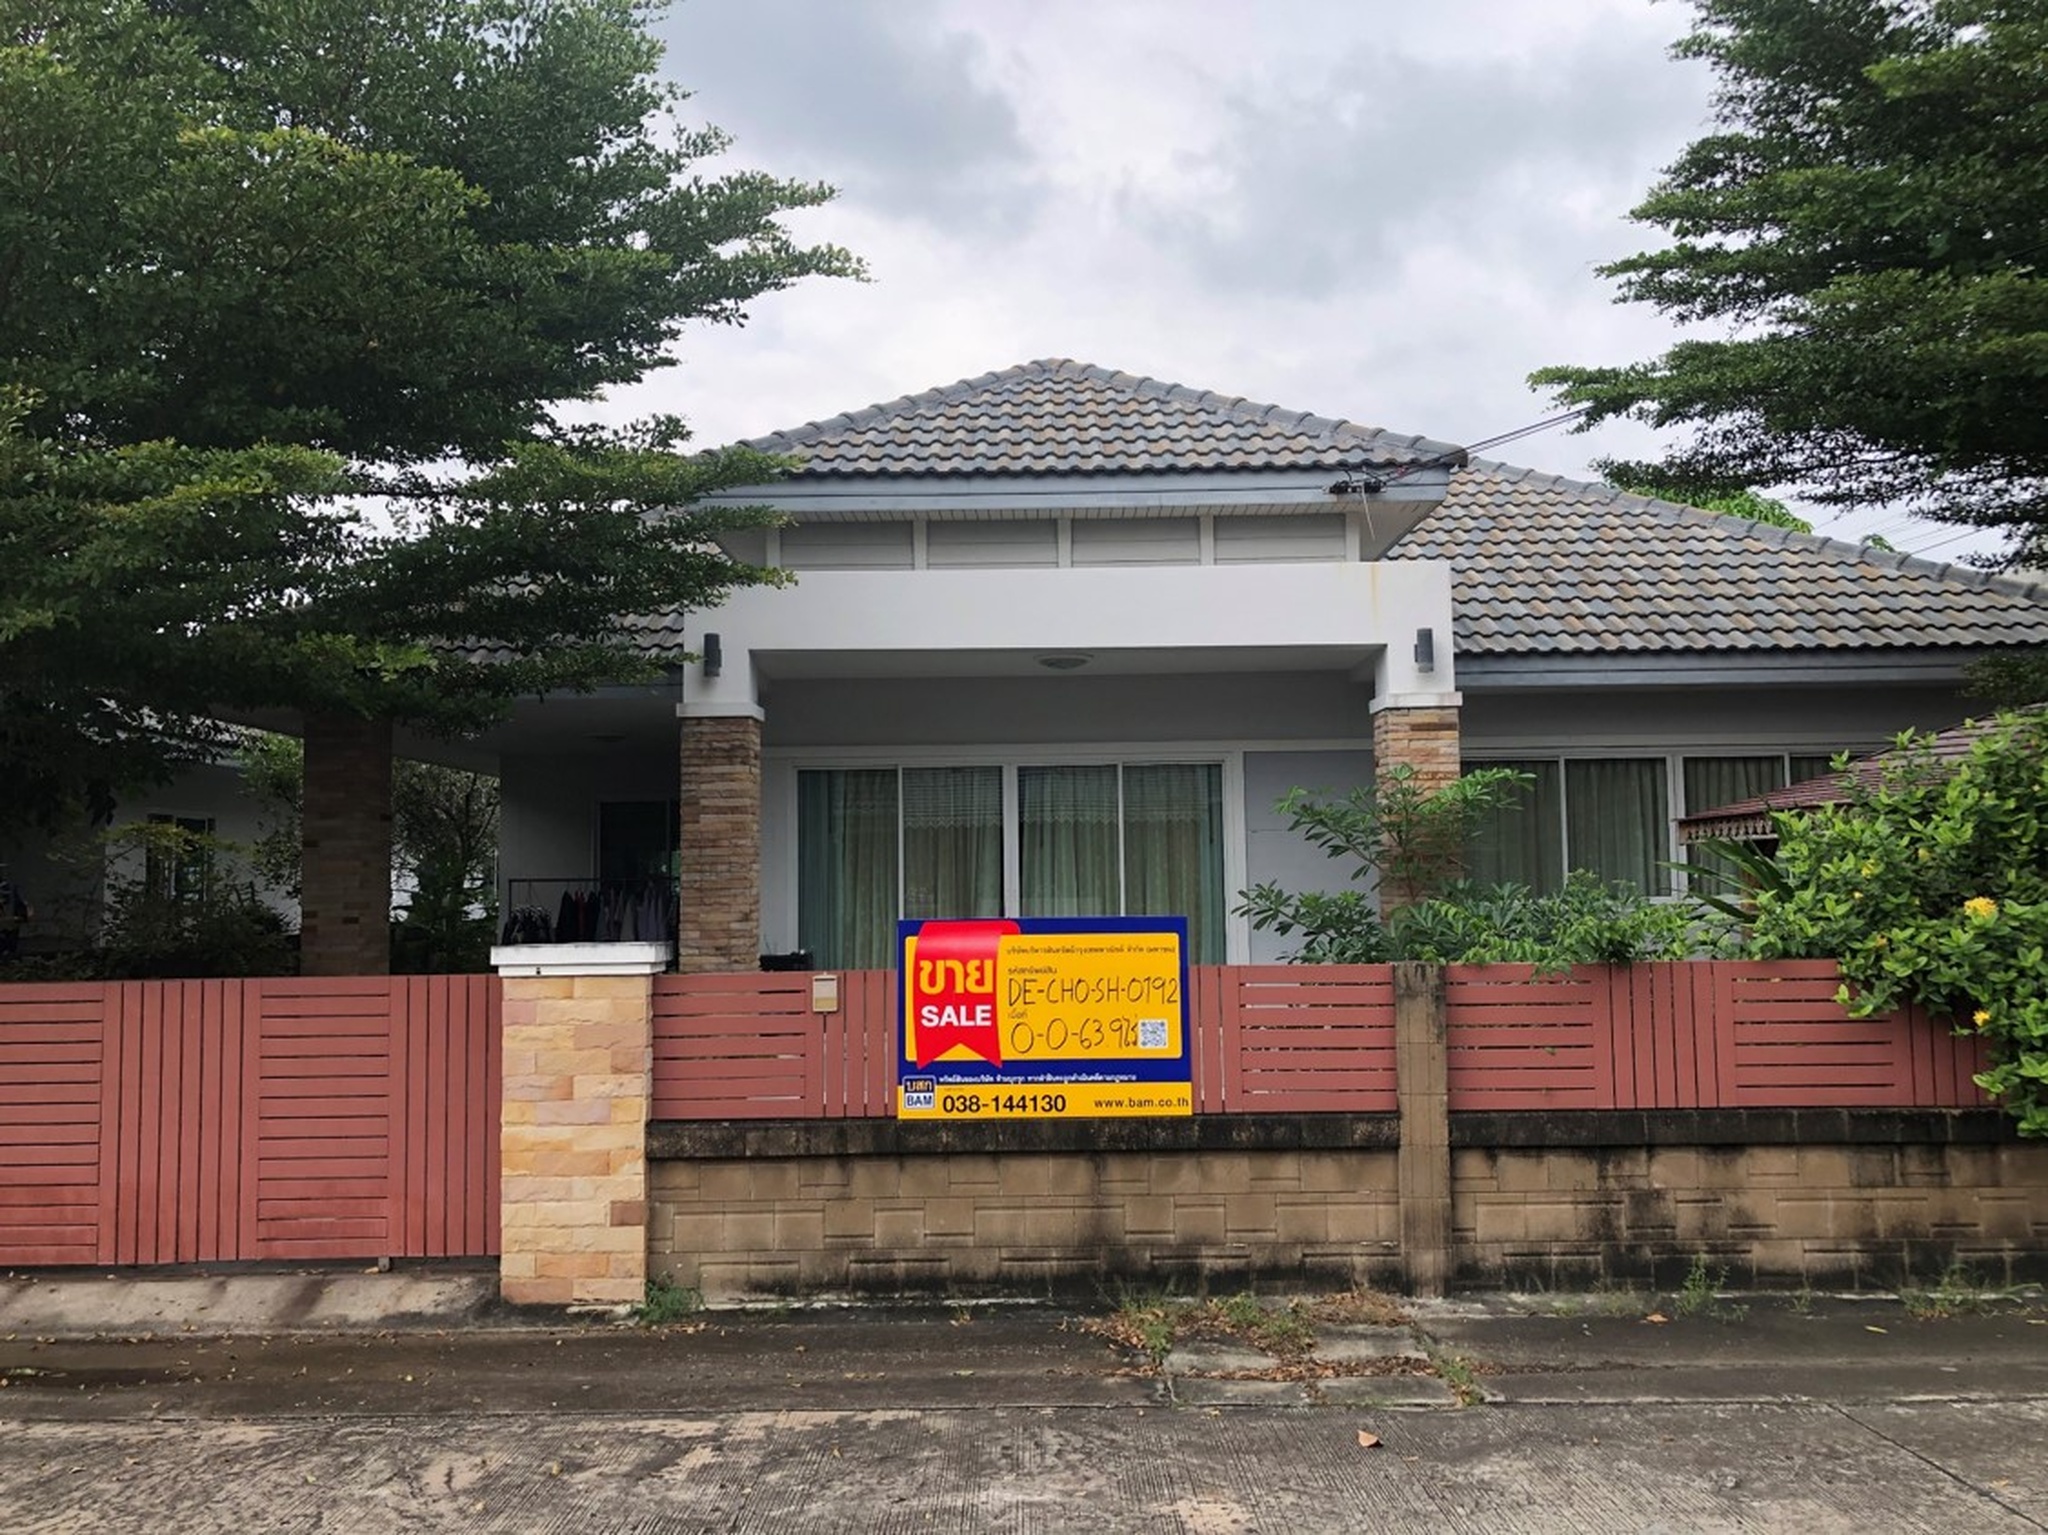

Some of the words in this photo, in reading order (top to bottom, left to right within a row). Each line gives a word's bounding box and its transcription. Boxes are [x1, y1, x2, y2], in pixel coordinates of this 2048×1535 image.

[919, 959, 994, 995] ขาย
[921, 1005, 992, 1028] SALE
[907, 1094, 932, 1106] BAM
[942, 1094, 1066, 1113] 038-144130
[1094, 1097, 1189, 1108] www.bam.co.th
